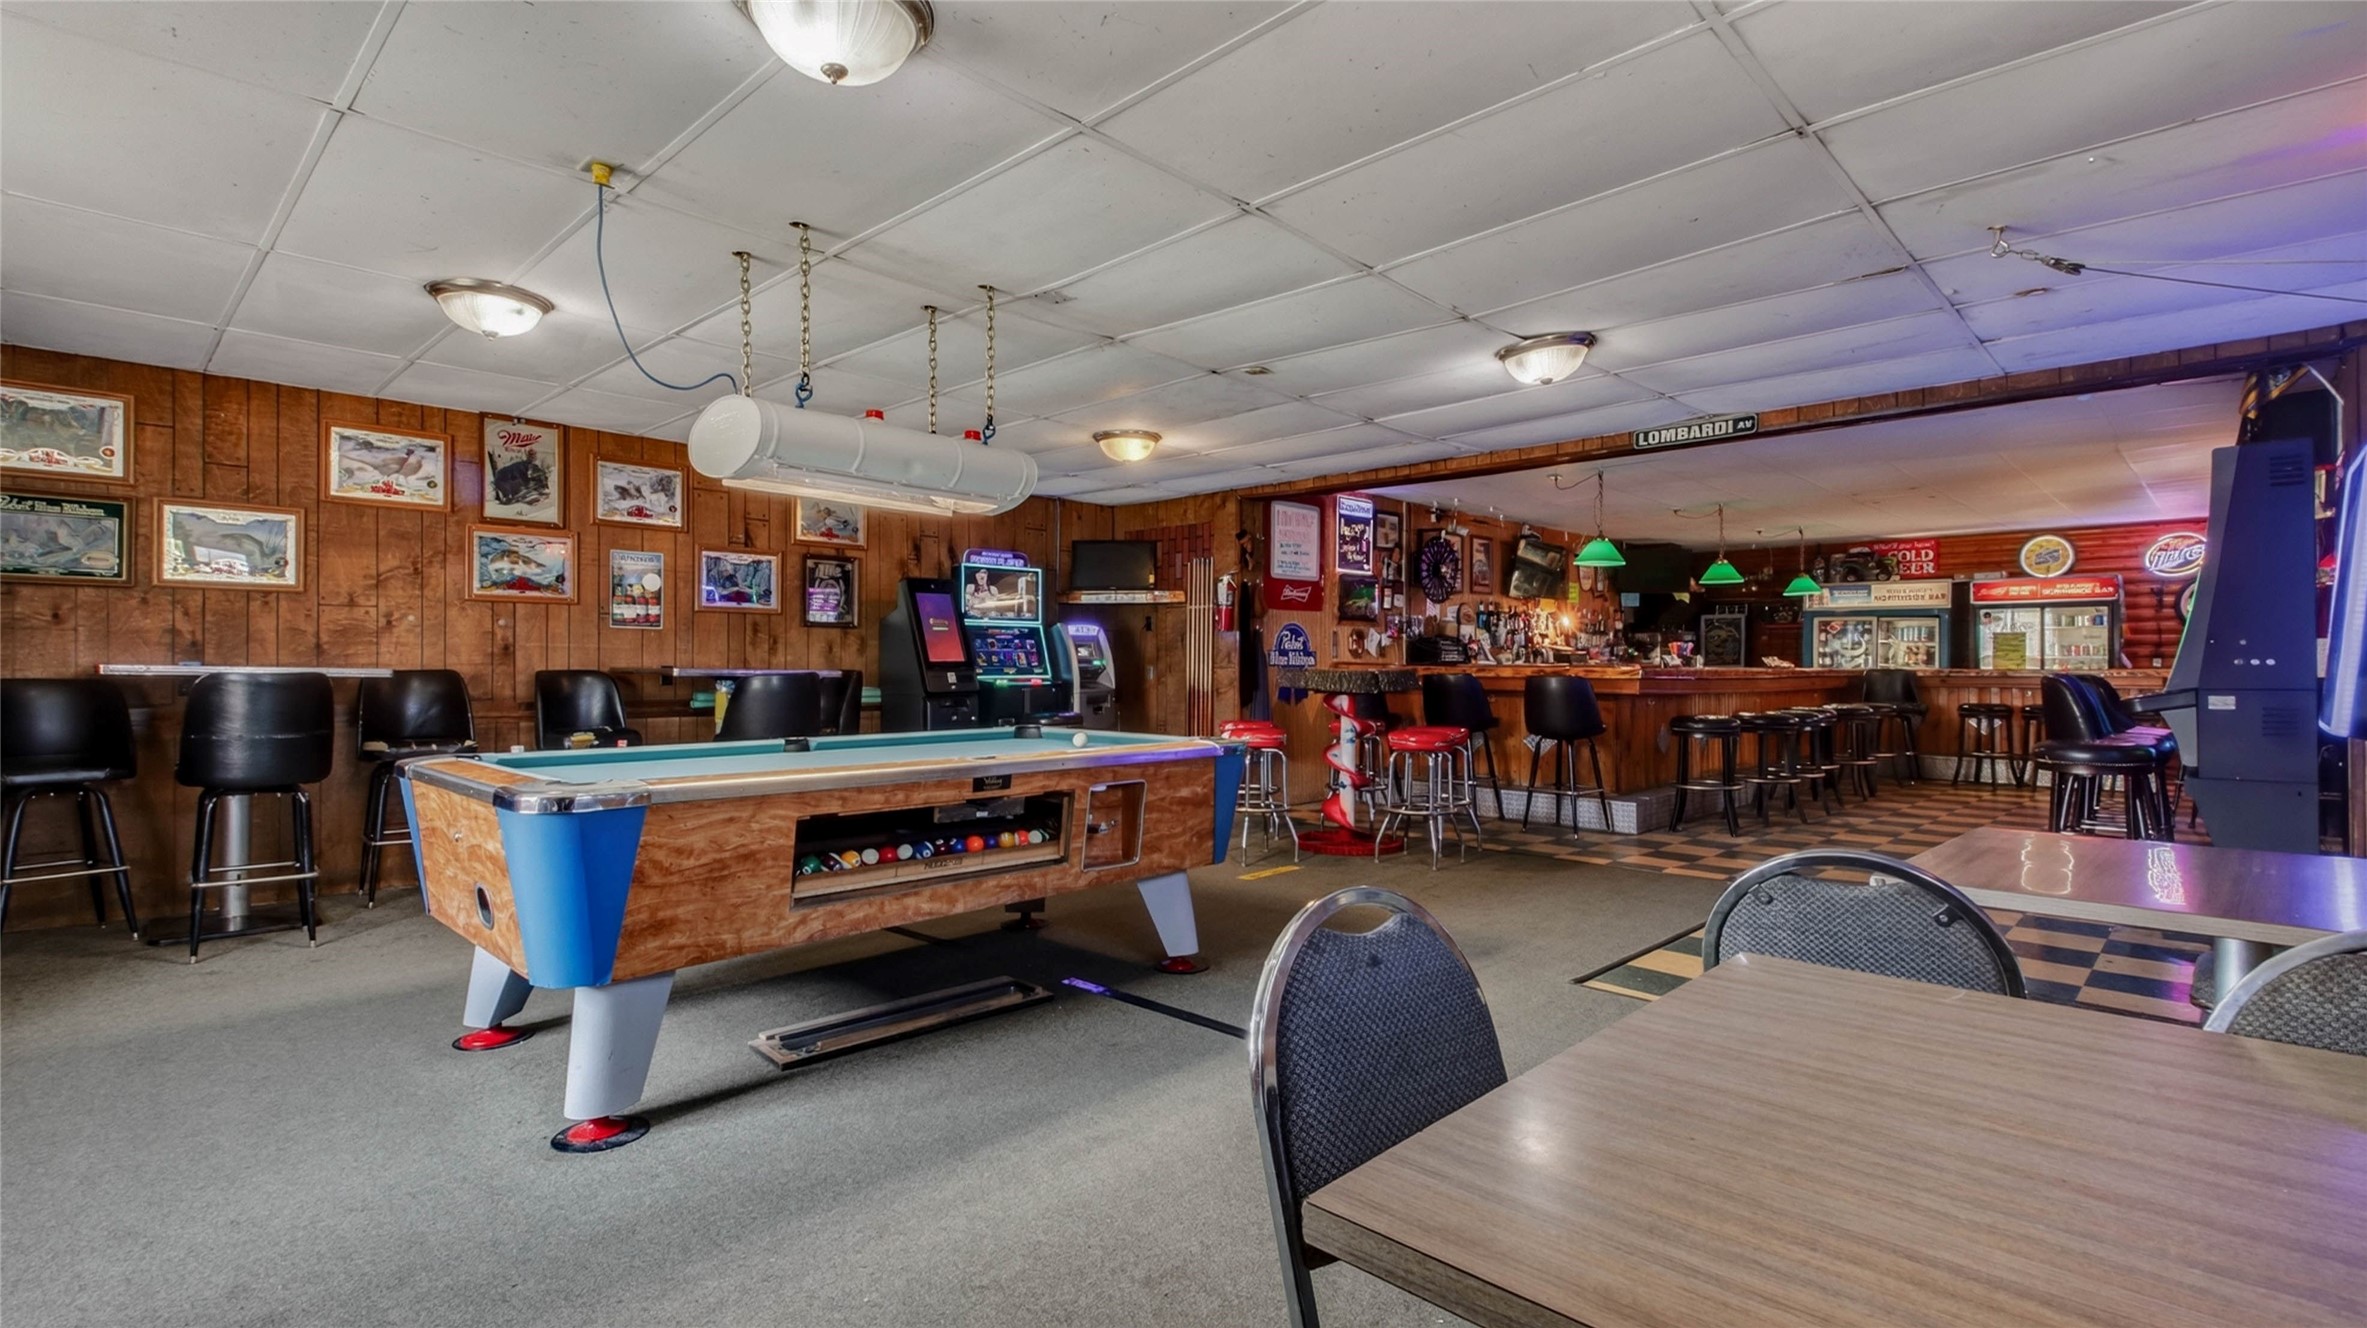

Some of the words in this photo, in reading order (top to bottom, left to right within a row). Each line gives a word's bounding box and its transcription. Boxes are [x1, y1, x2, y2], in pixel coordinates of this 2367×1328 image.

[1638, 420, 1734, 446] LOMBARDI
[1737, 419, 1753, 430] AV
[1898, 562, 1936, 575] EER
